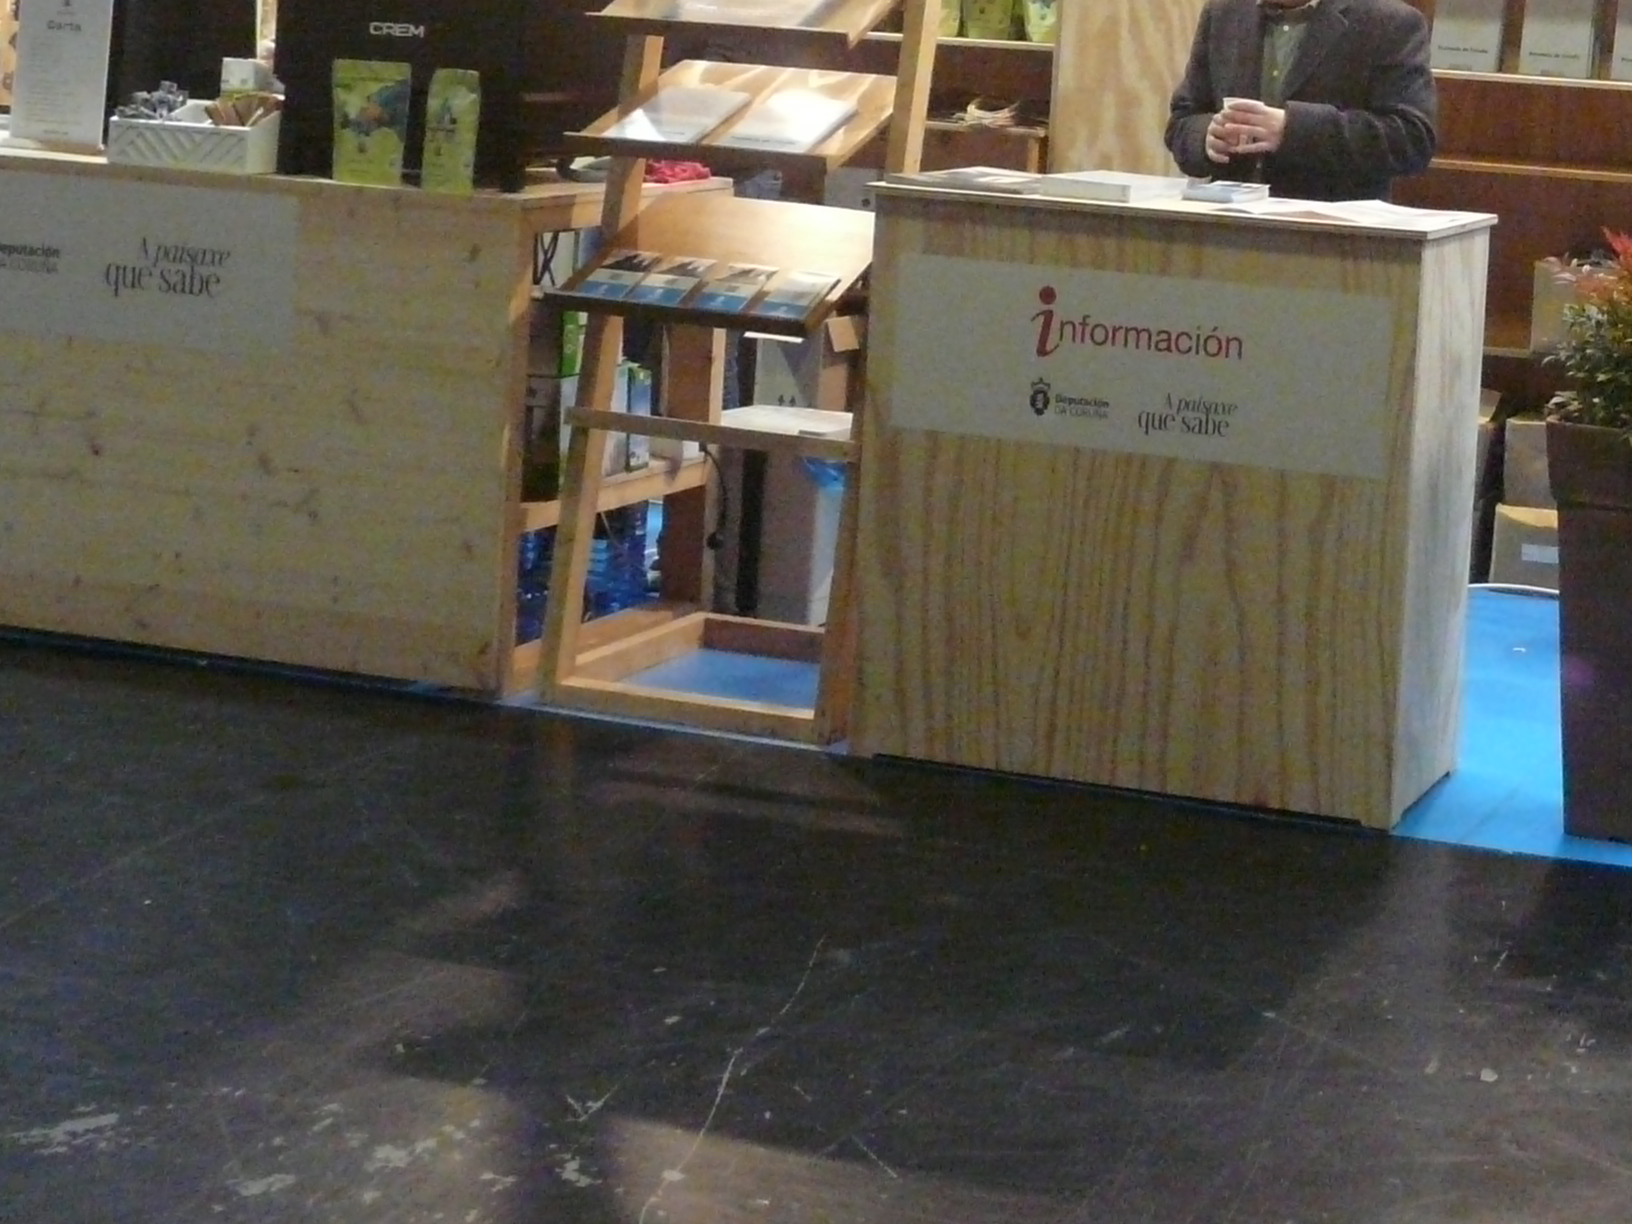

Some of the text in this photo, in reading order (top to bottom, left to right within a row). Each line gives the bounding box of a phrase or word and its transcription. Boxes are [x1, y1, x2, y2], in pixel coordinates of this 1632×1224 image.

[369, 21, 425, 38] CREM
[0, 241, 60, 259] eputación
[104, 262, 221, 298] que sabe
[1137, 409, 1230, 438] que sabe
